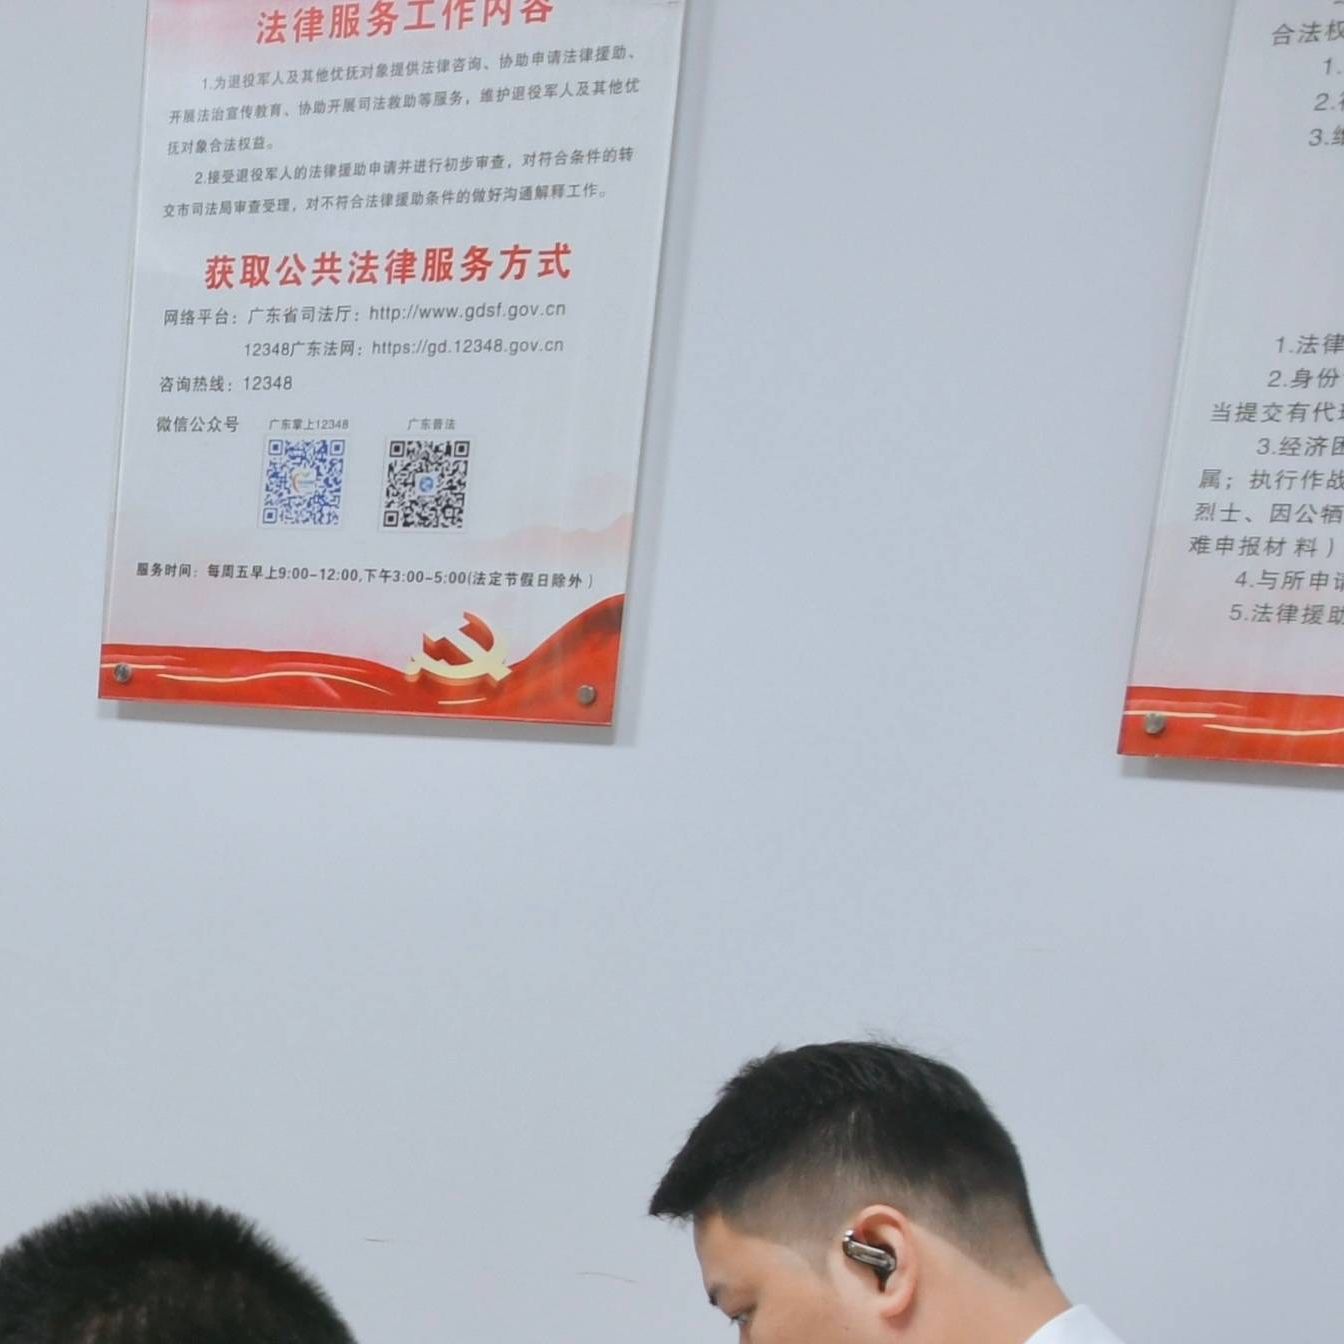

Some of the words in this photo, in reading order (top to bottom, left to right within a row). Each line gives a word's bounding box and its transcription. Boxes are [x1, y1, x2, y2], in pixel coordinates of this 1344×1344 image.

[256, 0, 554, 45] 法律服务工作内容
[202, 44, 636, 91] 1.为退役军人及其他优抚对象提供法律咨询、协助申请法律援助、
[168, 77, 640, 125] 开展法治宣传教育、协助开展司法救助等服务，维护退役军人及其他优
[167, 136, 274, 155] 抚对象合法权益。
[194, 146, 634, 185] 2.接受退役军人的法律援助申请并进行初步审查，对符合条件的转
[163, 183, 607, 218] 交市司法局审查受理，对不符合法律援助条件的做好沟通解释工作。
[204, 241, 573, 290] 获取公共法律服务方式
[1267, 367, 1344, 389] 2.身份
[156, 415, 239, 433] 微信公众号
[268, 418, 349, 431] 广东掌上12348
[407, 418, 456, 431] 广东普法
